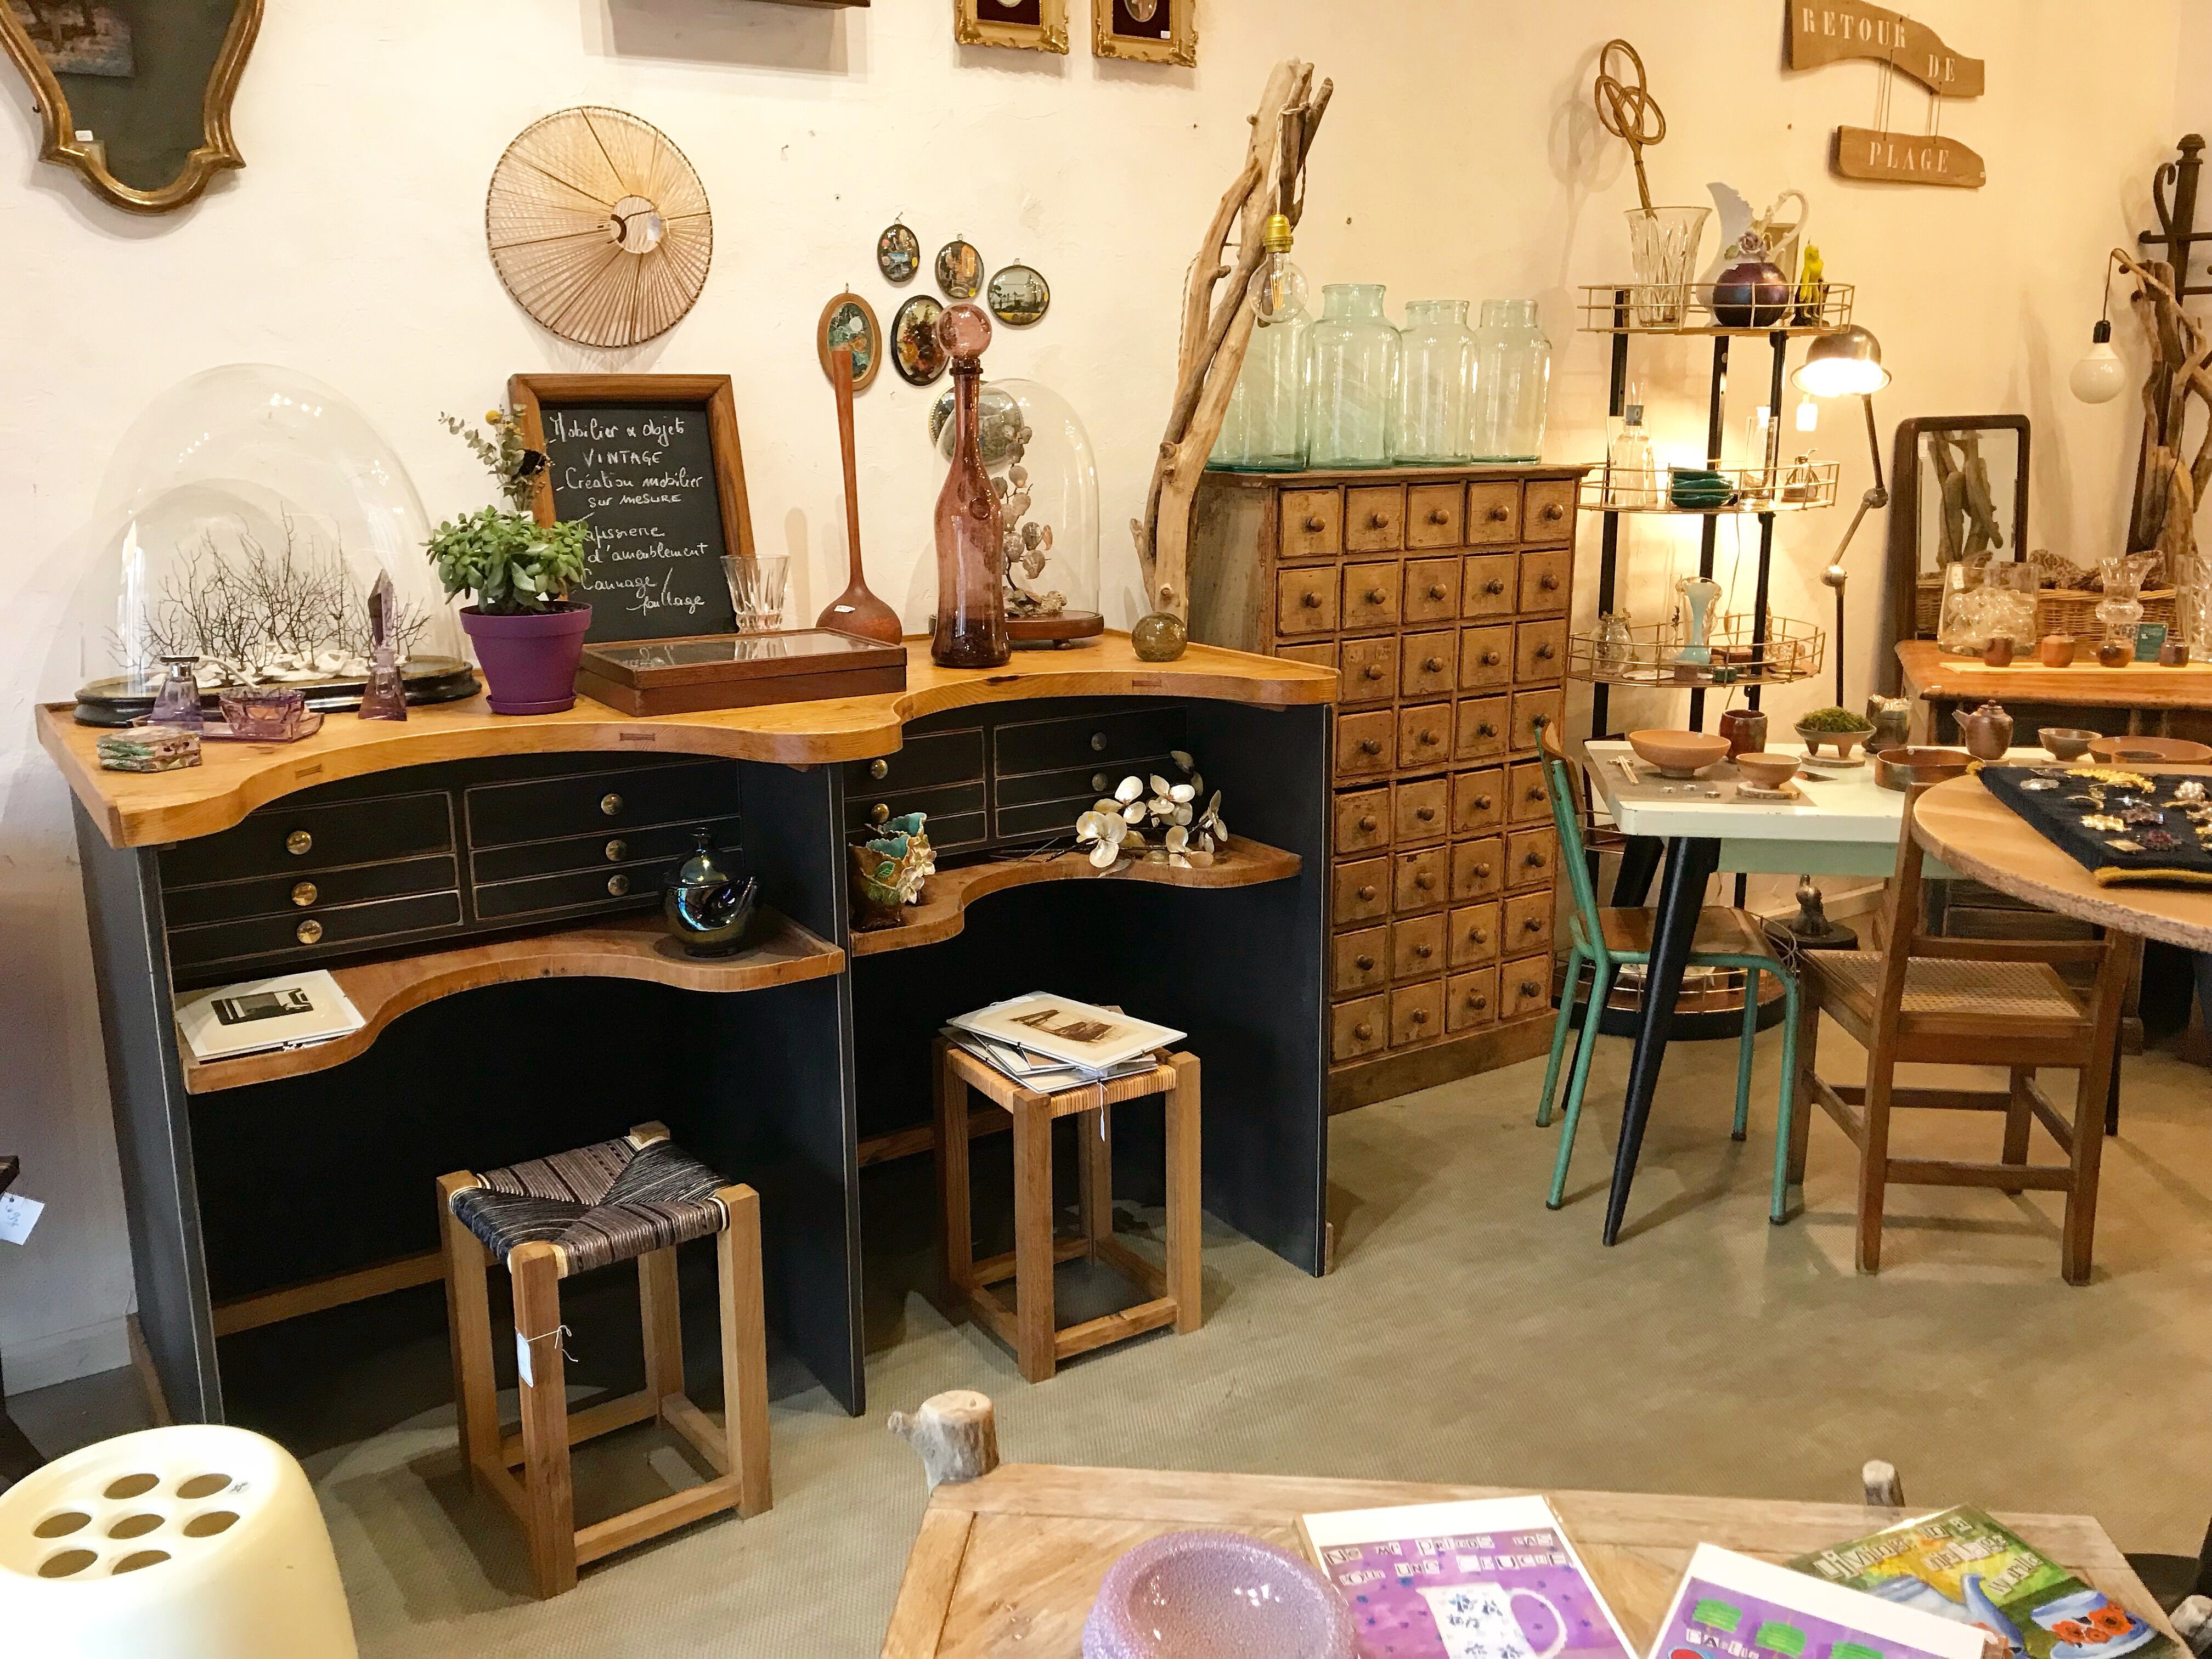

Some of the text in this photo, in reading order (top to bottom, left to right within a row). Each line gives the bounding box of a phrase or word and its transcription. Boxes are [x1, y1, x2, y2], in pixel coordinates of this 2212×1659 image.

[1803, 8, 1955, 82] RETOUR DE
[1869, 142, 1949, 173] PLAGE
[582, 448, 662, 466] VINTAGE
